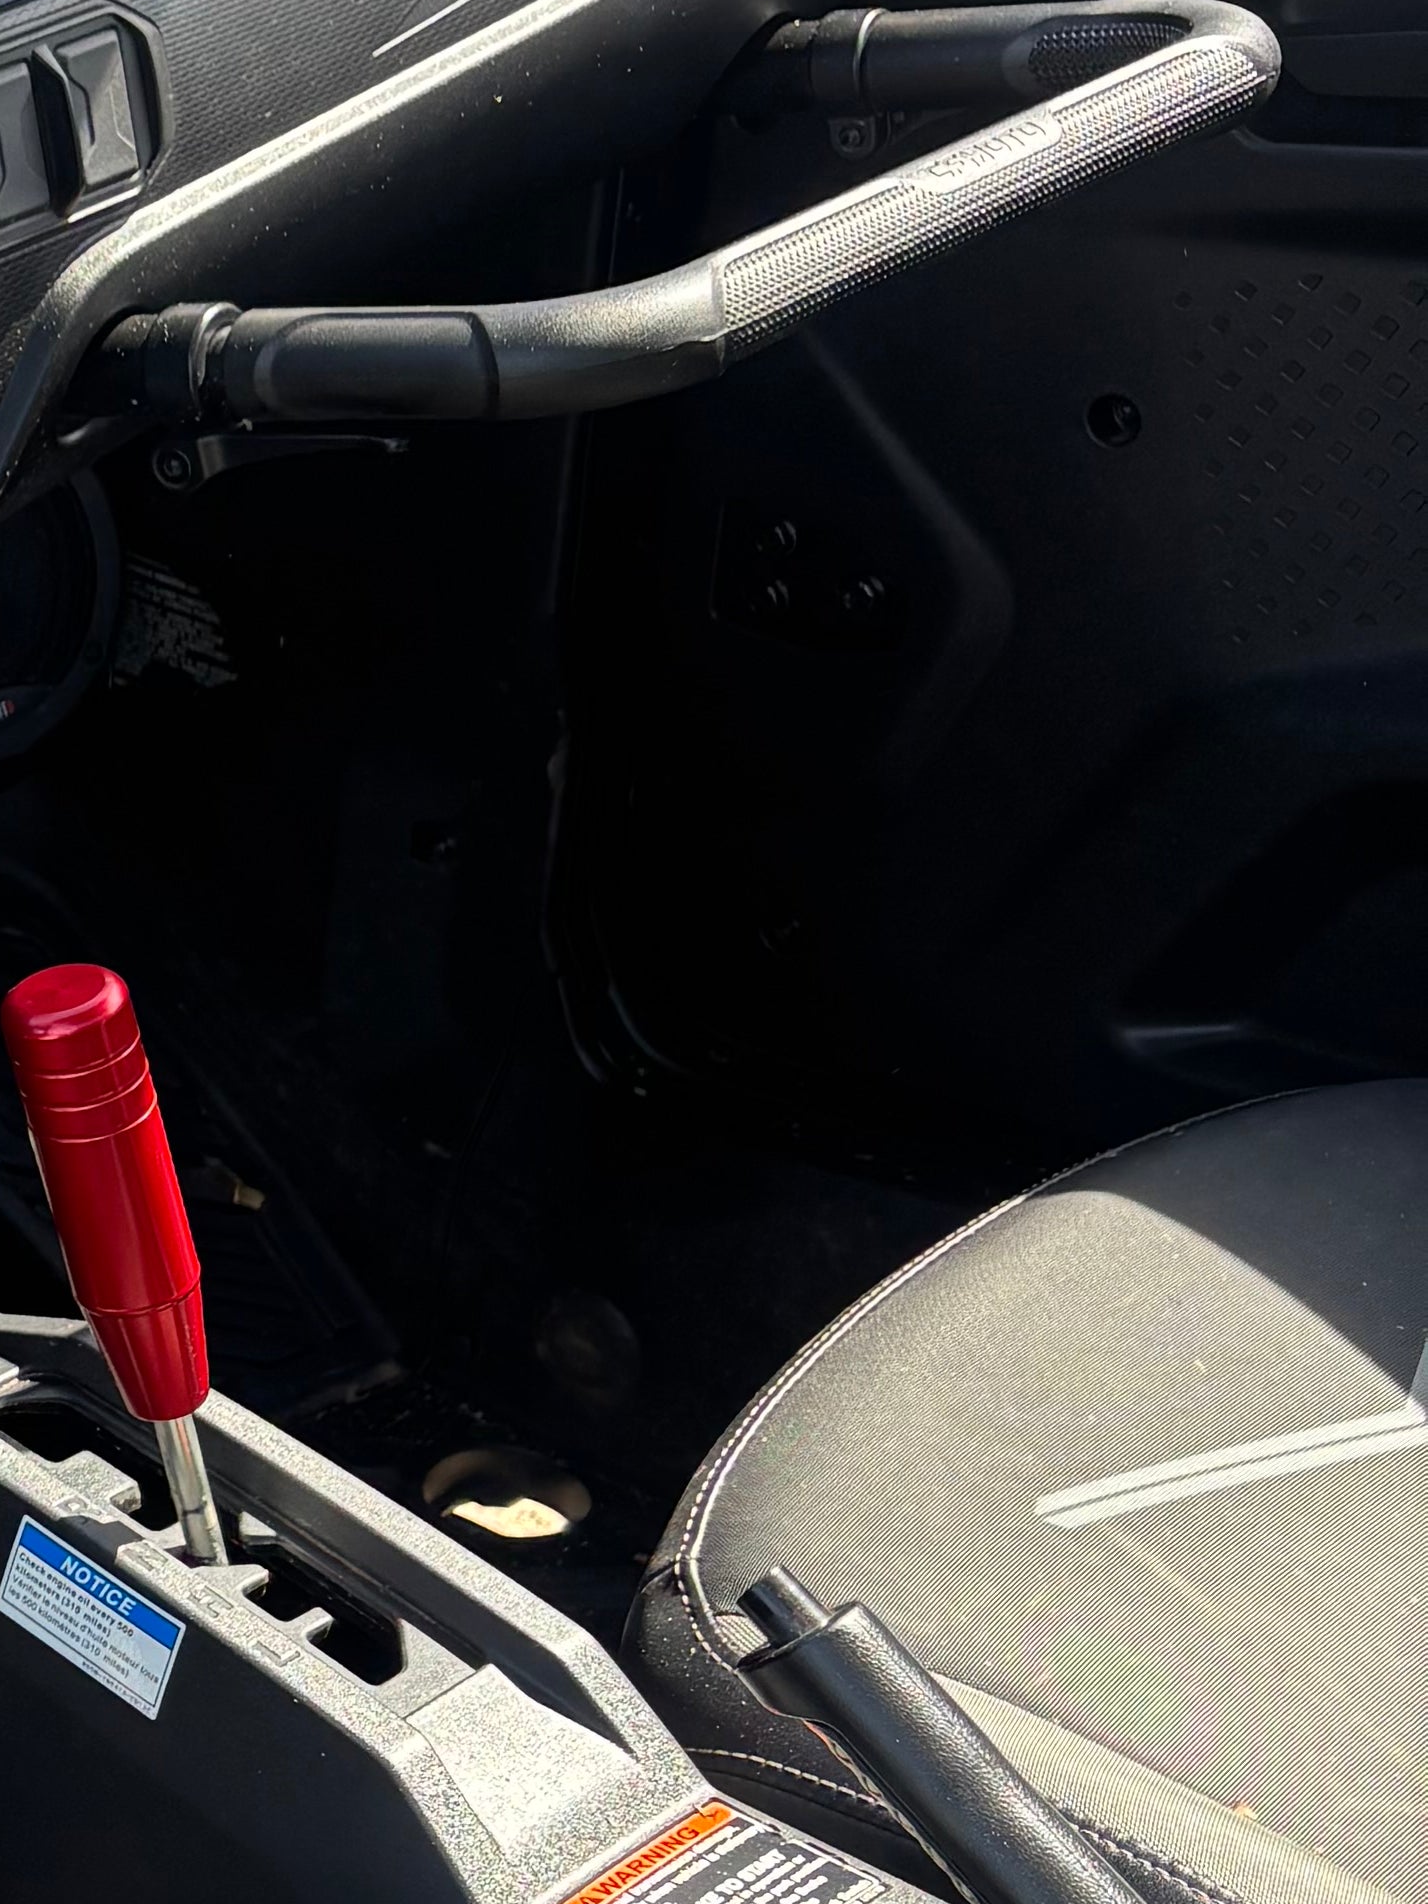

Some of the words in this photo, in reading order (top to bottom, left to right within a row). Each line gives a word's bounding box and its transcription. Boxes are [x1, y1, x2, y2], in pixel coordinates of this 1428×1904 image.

[14, 1562, 60, 1601] kilometers
[82, 1611, 111, 1638] miles)
[18, 1551, 46, 1576] Check
[45, 1571, 76, 1600] engine
[77, 1592, 89, 1607] oil
[89, 1602, 115, 1627] every
[116, 1620, 133, 1638] 500
[41, 1595, 51, 1607] le
[50, 1602, 79, 1628] niveau
[59, 1552, 136, 1620] NOTICE
[8, 1584, 21, 1600] les
[21, 1594, 37, 1612] 500
[102, 1652, 129, 1679] miles)
[592, 1827, 700, 1896] WARNING
[712, 1876, 747, 1897] TO
